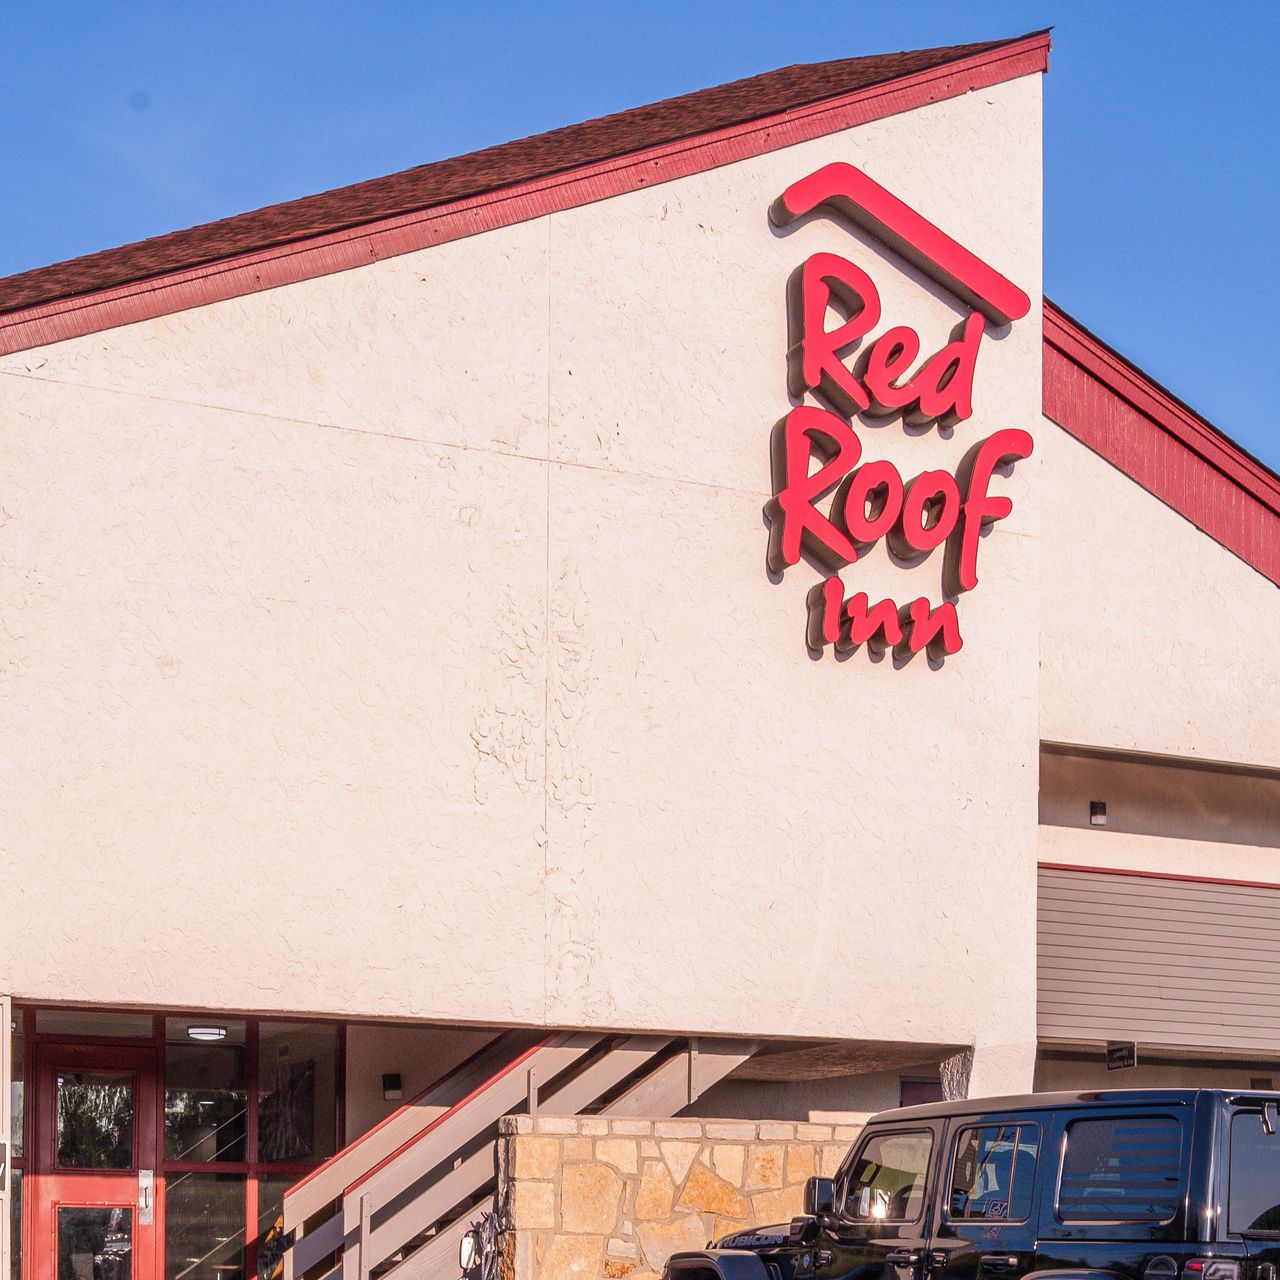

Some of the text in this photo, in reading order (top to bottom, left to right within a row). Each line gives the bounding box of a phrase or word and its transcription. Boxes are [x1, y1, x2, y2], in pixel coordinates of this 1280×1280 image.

[796, 252, 986, 422] Red
[776, 404, 1035, 592] Roof
[722, 1234, 785, 1248] RUBICON
